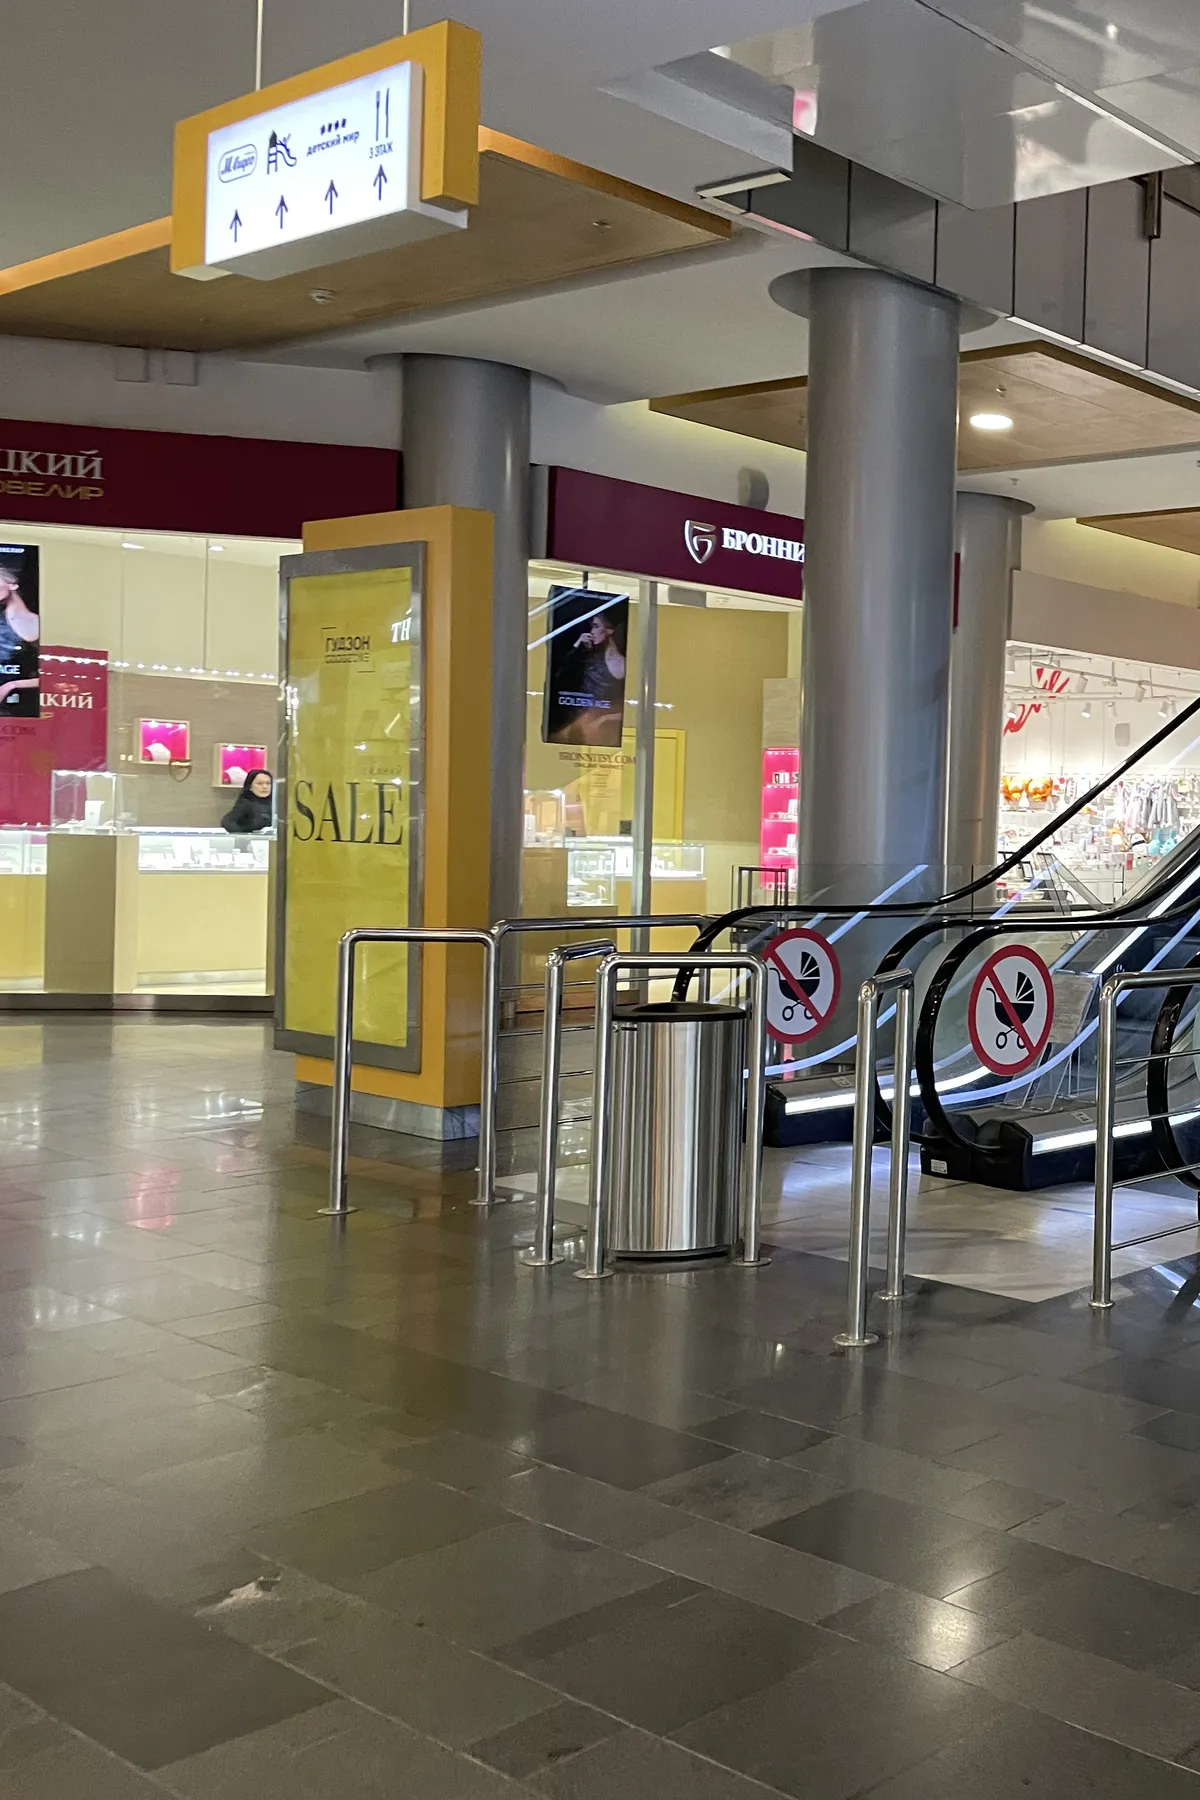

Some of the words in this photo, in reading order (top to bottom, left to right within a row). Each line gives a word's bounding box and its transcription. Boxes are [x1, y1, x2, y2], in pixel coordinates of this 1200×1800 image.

[306, 133, 341, 157] детский
[342, 131, 360, 144] мир
[325, 635, 371, 652] ГУДЗОН
[293, 779, 404, 846] SALE
